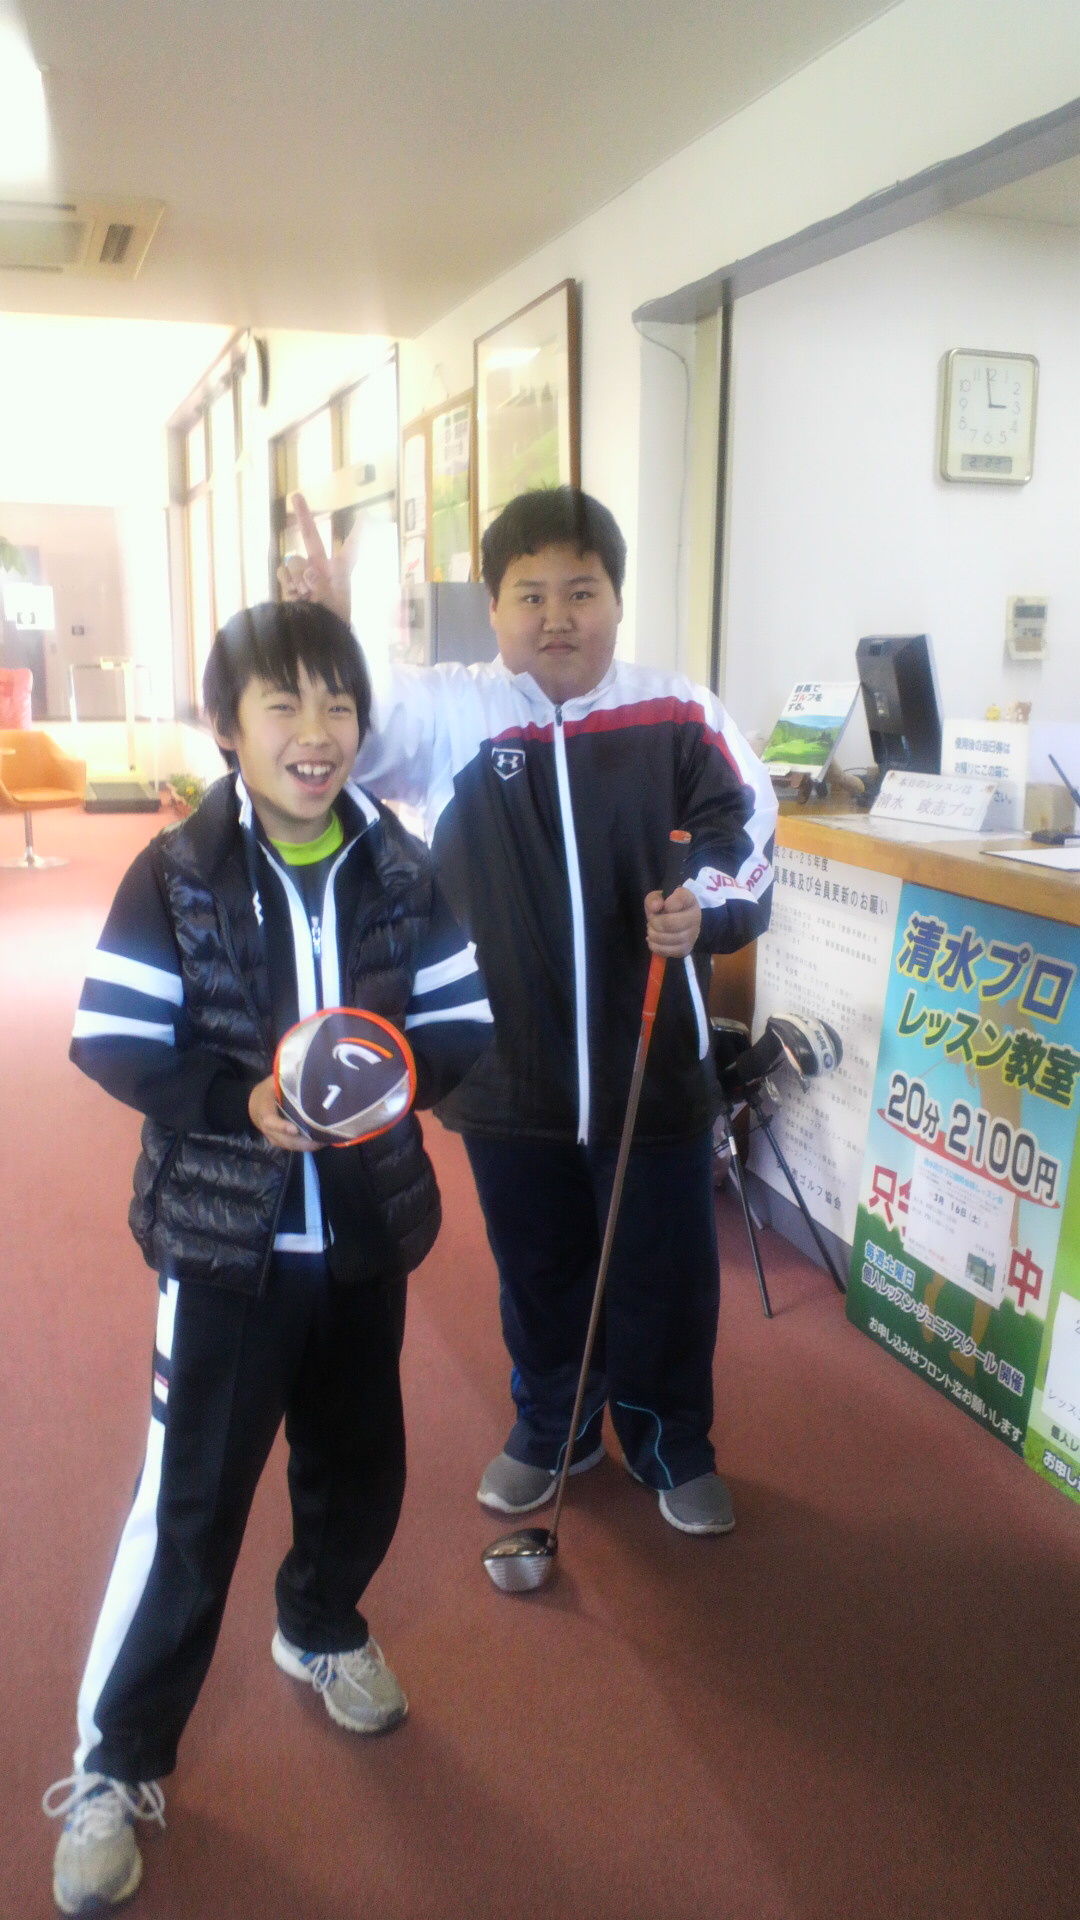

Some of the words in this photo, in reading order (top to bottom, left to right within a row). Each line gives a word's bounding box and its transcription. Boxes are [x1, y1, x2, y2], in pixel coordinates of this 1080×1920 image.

[791, 693, 823, 702] ゴルフを
[897, 911, 1076, 1023] 清水プロ
[897, 989, 1080, 1109] レッスン教室
[321, 1084, 342, 1111] 1
[886, 1072, 941, 1142] 20分
[947, 1102, 1060, 1202] 2100円
[864, 1240, 916, 1291] 毎週土曜日
